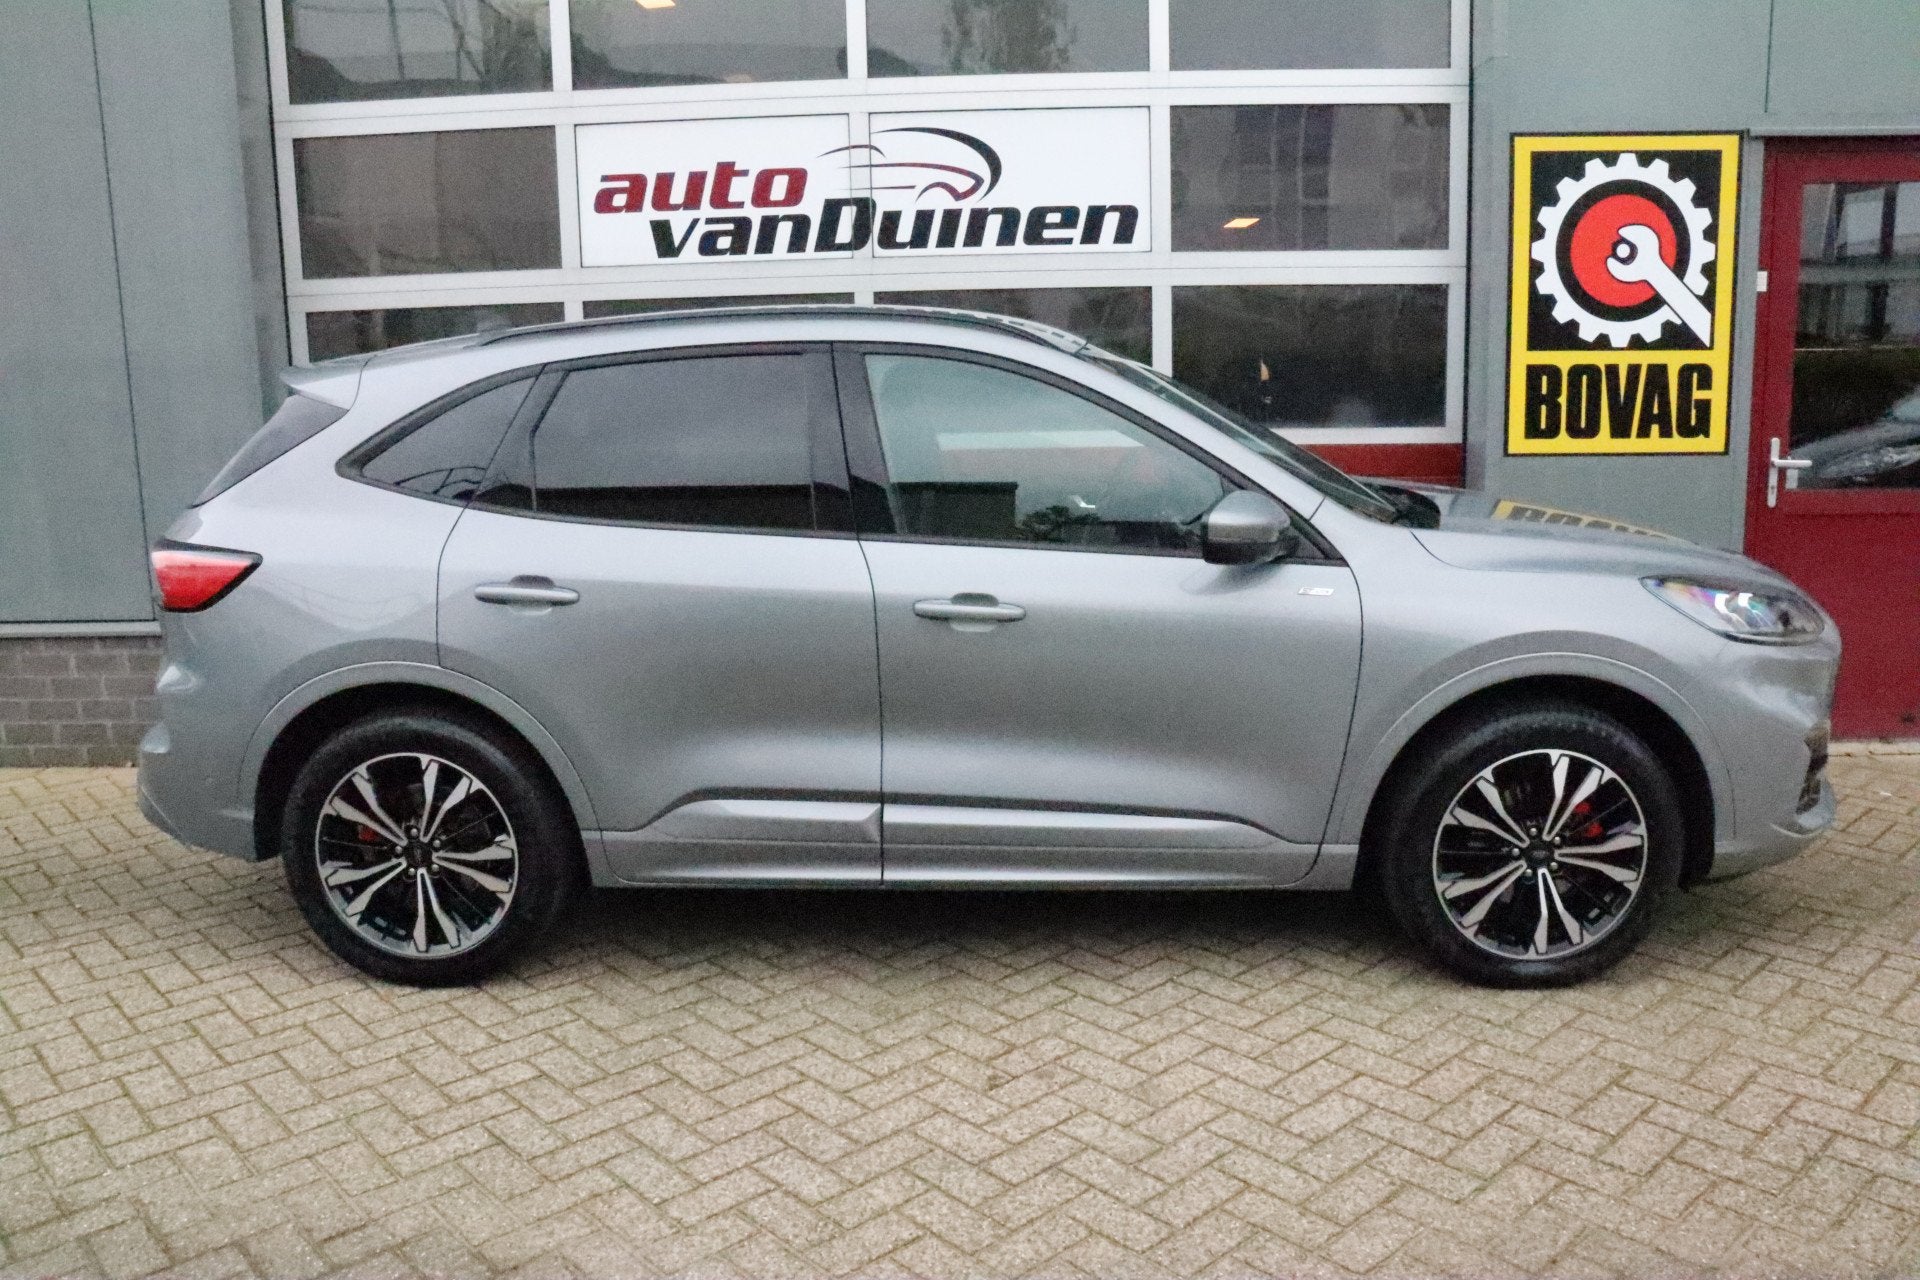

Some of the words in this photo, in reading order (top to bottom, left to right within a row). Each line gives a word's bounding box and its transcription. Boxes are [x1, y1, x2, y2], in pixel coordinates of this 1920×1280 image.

[594, 161, 808, 214] auto
[649, 196, 1139, 259] vanDuinen
[1524, 363, 1713, 439] BOVAG
